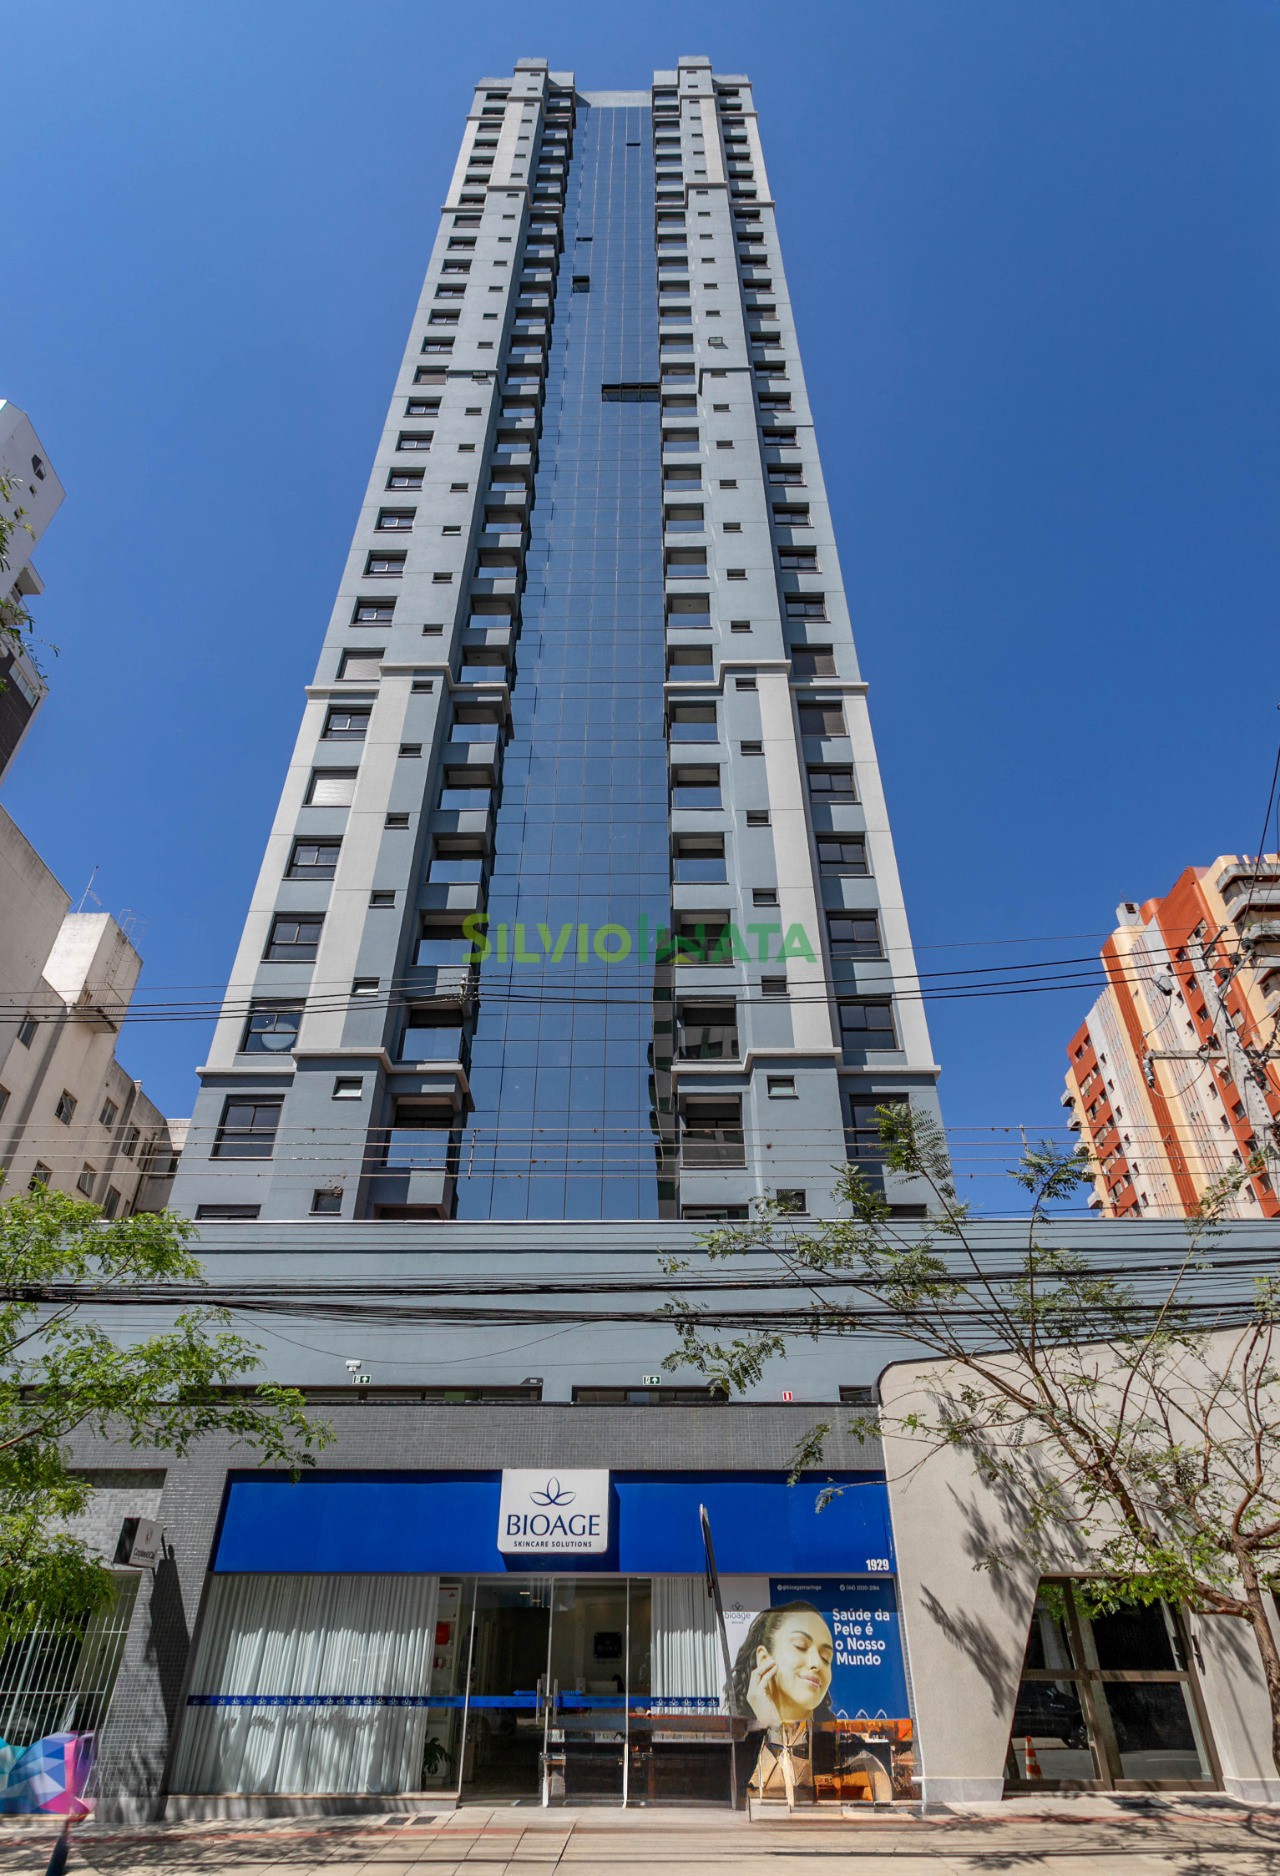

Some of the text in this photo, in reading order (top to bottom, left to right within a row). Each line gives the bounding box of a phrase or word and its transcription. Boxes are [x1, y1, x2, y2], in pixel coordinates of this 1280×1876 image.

[506, 1514, 600, 1536] BIOAGE
[513, 1540, 592, 1548] SKINCARE SOLUTIONS
[865, 1558, 890, 1571] 1929
[724, 1609, 751, 1621] bioage
[832, 1608, 890, 1621] Saúde da
[833, 1622, 874, 1635] Pele é
[835, 1637, 886, 1650] o Nosso
[836, 1652, 881, 1665] Mundo
